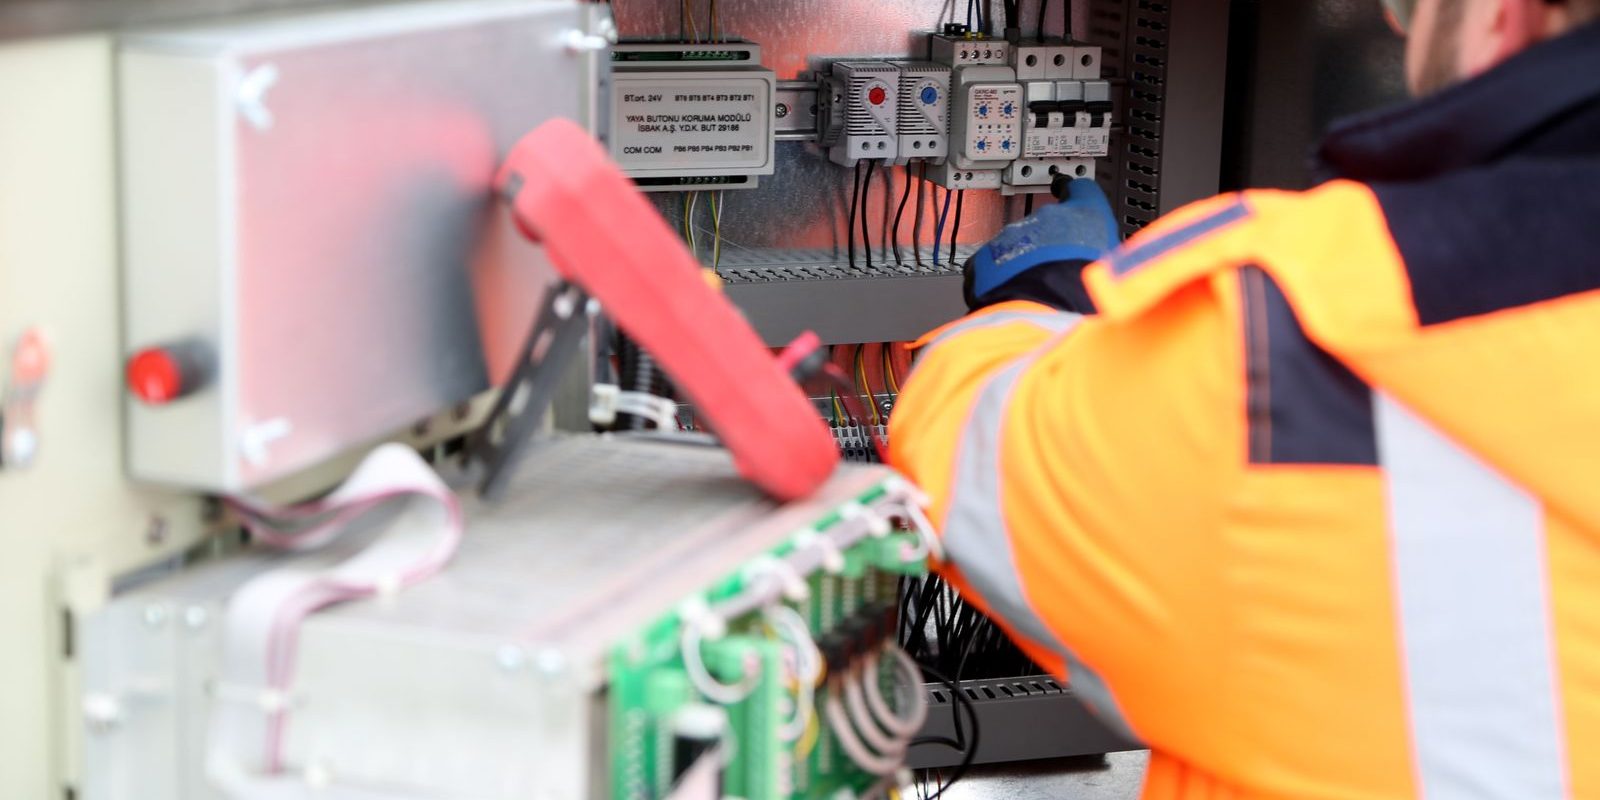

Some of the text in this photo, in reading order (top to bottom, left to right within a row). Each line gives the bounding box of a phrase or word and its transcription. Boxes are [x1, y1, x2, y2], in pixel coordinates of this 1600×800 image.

[648, 94, 662, 102] 24V
[681, 114, 716, 122] KORUMA
[717, 113, 751, 122] MODÜLÜ
[637, 124, 661, 132] İSBAK
[662, 125, 676, 133] A.Ş.
[701, 124, 716, 132] BUT
[623, 146, 662, 154] COM COM
